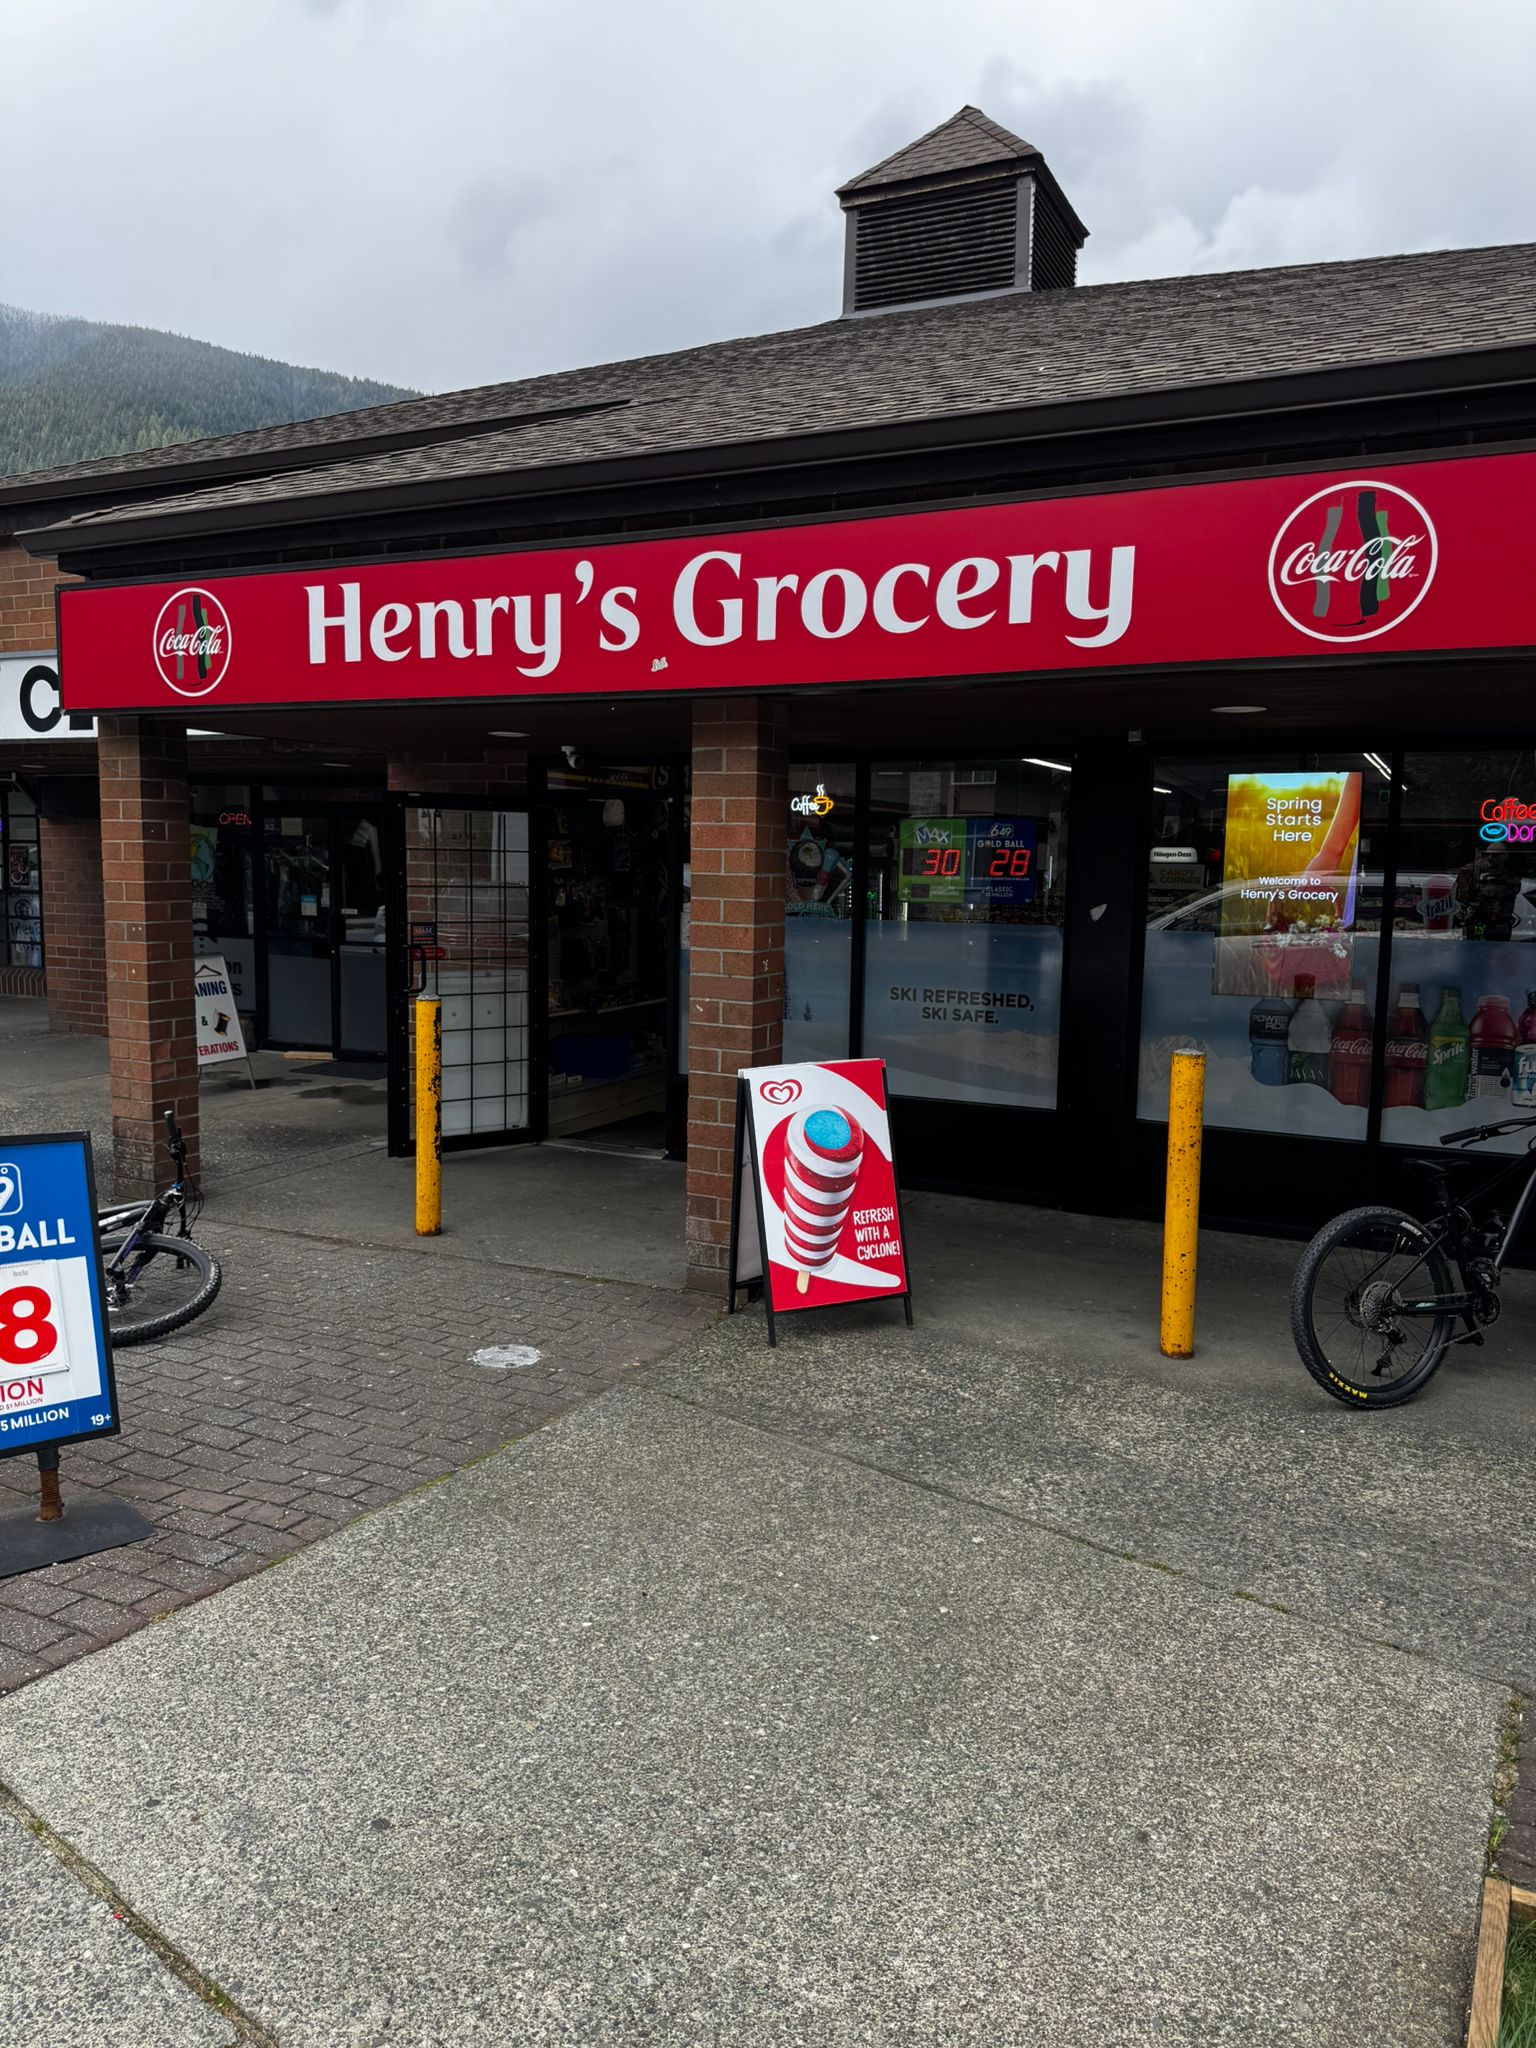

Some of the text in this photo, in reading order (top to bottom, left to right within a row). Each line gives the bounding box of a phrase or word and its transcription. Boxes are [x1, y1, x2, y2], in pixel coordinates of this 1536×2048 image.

[304, 546, 1137, 677] Henry's Grocery
[791, 795, 820, 816] Coffee
[1266, 797, 1322, 814] Spring
[218, 812, 252, 825] OPEN
[1265, 813, 1322, 827] Starts
[914, 826, 951, 845] MAX
[1004, 840, 1024, 848] BALL
[1273, 829, 1312, 842] Here
[921, 849, 960, 877] 30
[989, 850, 1031, 877] 28
[1258, 876, 1321, 886] Welcome to
[1240, 888, 1339, 903] Henry's Grocery
[889, 986, 1035, 1012] SKI REFRESHED,
[921, 1006, 999, 1024] SKI SAFE.
[1432, 1042, 1465, 1065] Sprite
[853, 1207, 894, 1225] REFRESH
[855, 1224, 891, 1243] WITH A
[857, 1240, 900, 1260] CYCLONE!
[1328, 1371, 1368, 1399] MAXXIS
[10, 1407, 70, 1430] MILLION
[90, 1413, 112, 1426] 19+
